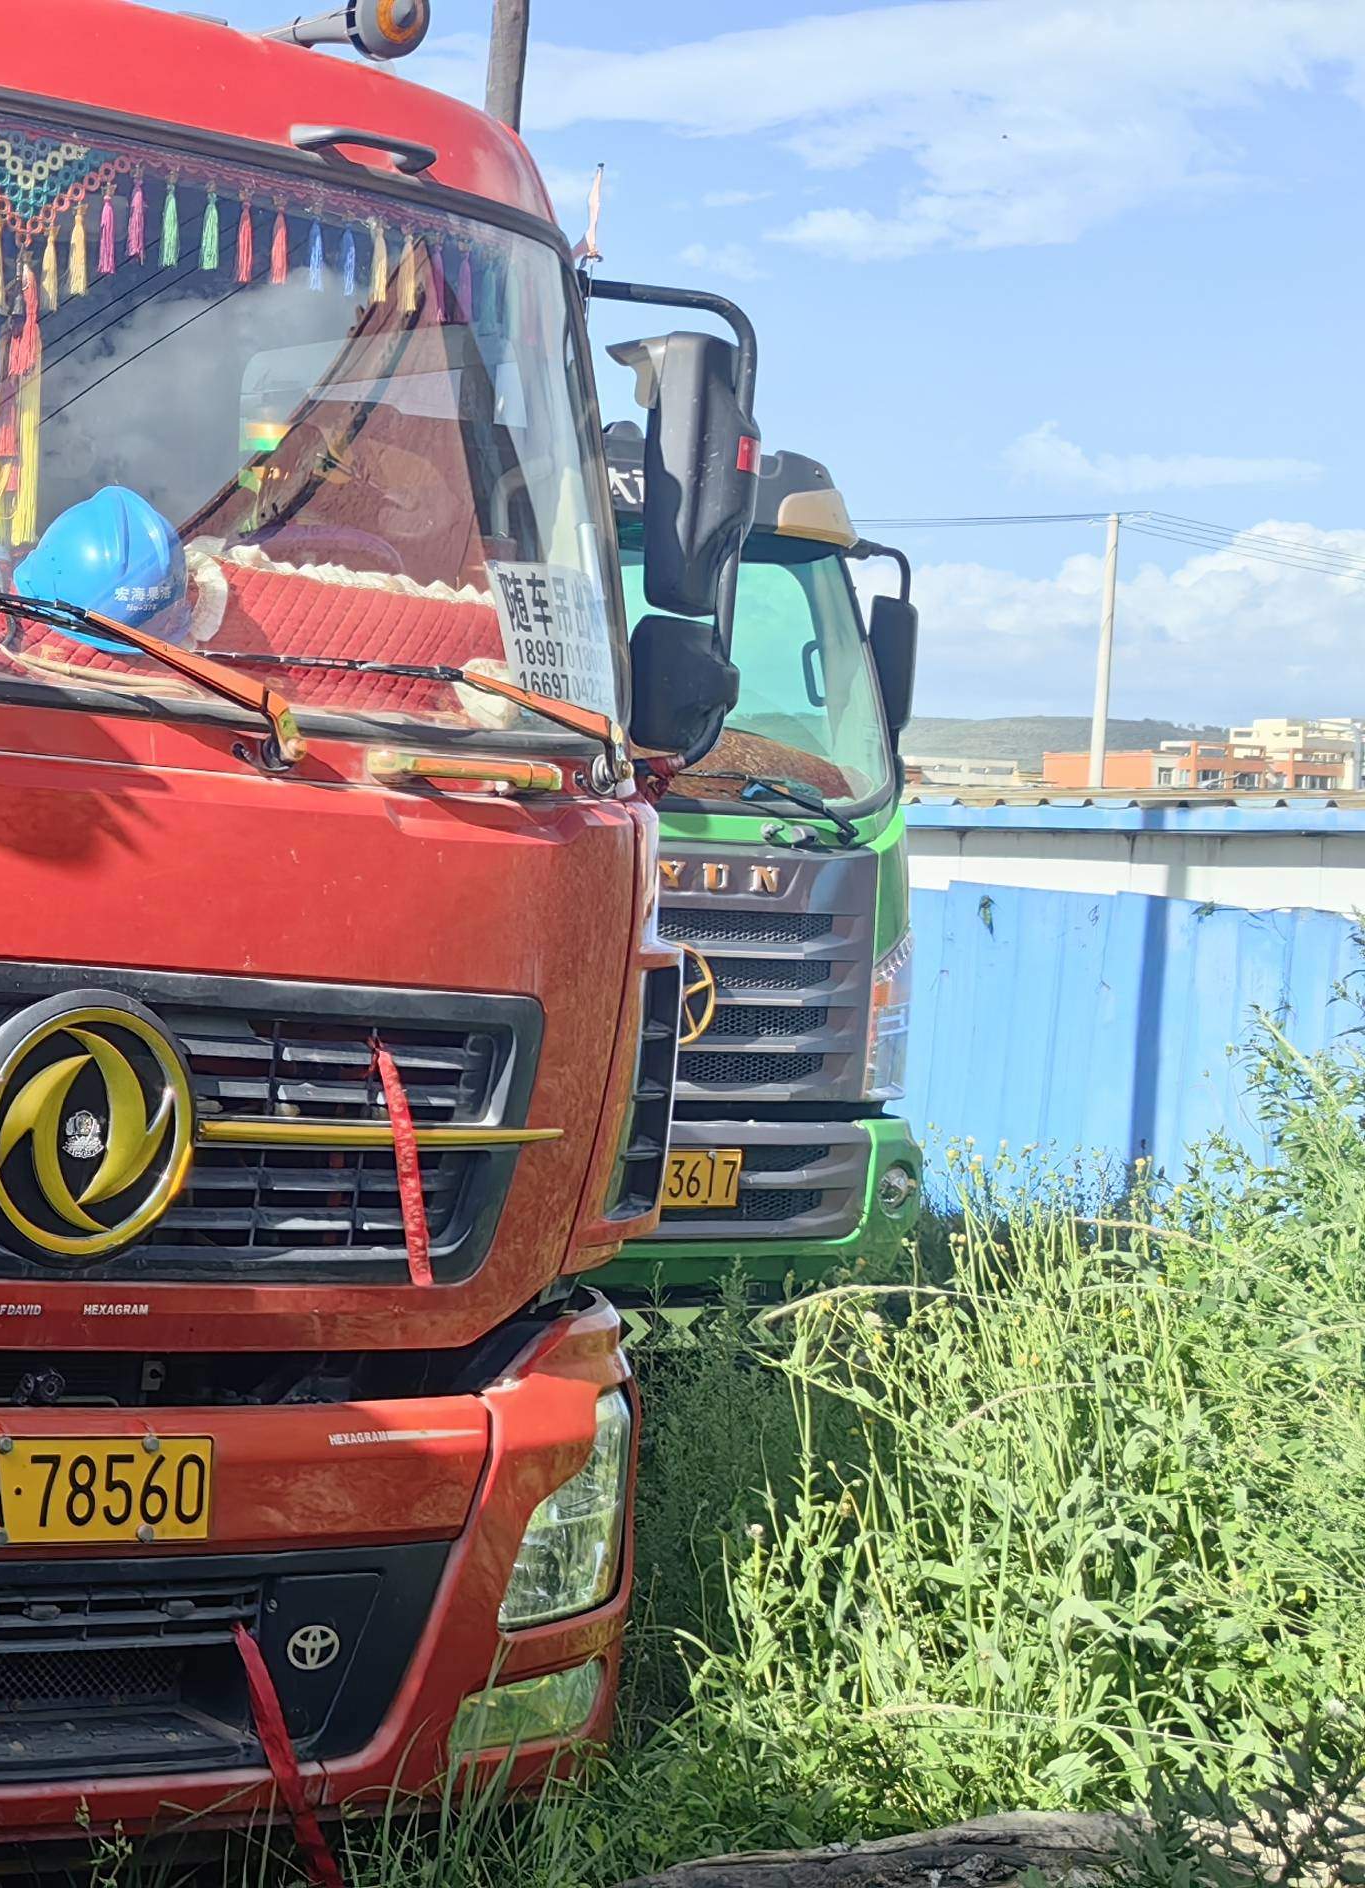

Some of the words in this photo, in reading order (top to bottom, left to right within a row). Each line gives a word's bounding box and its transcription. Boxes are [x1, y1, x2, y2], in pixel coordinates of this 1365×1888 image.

[7, 1304, 42, 1316] DAVID
[83, 1304, 149, 1316] HEXAGRAM
[328, 1430, 388, 1446] HEXAGRAM
